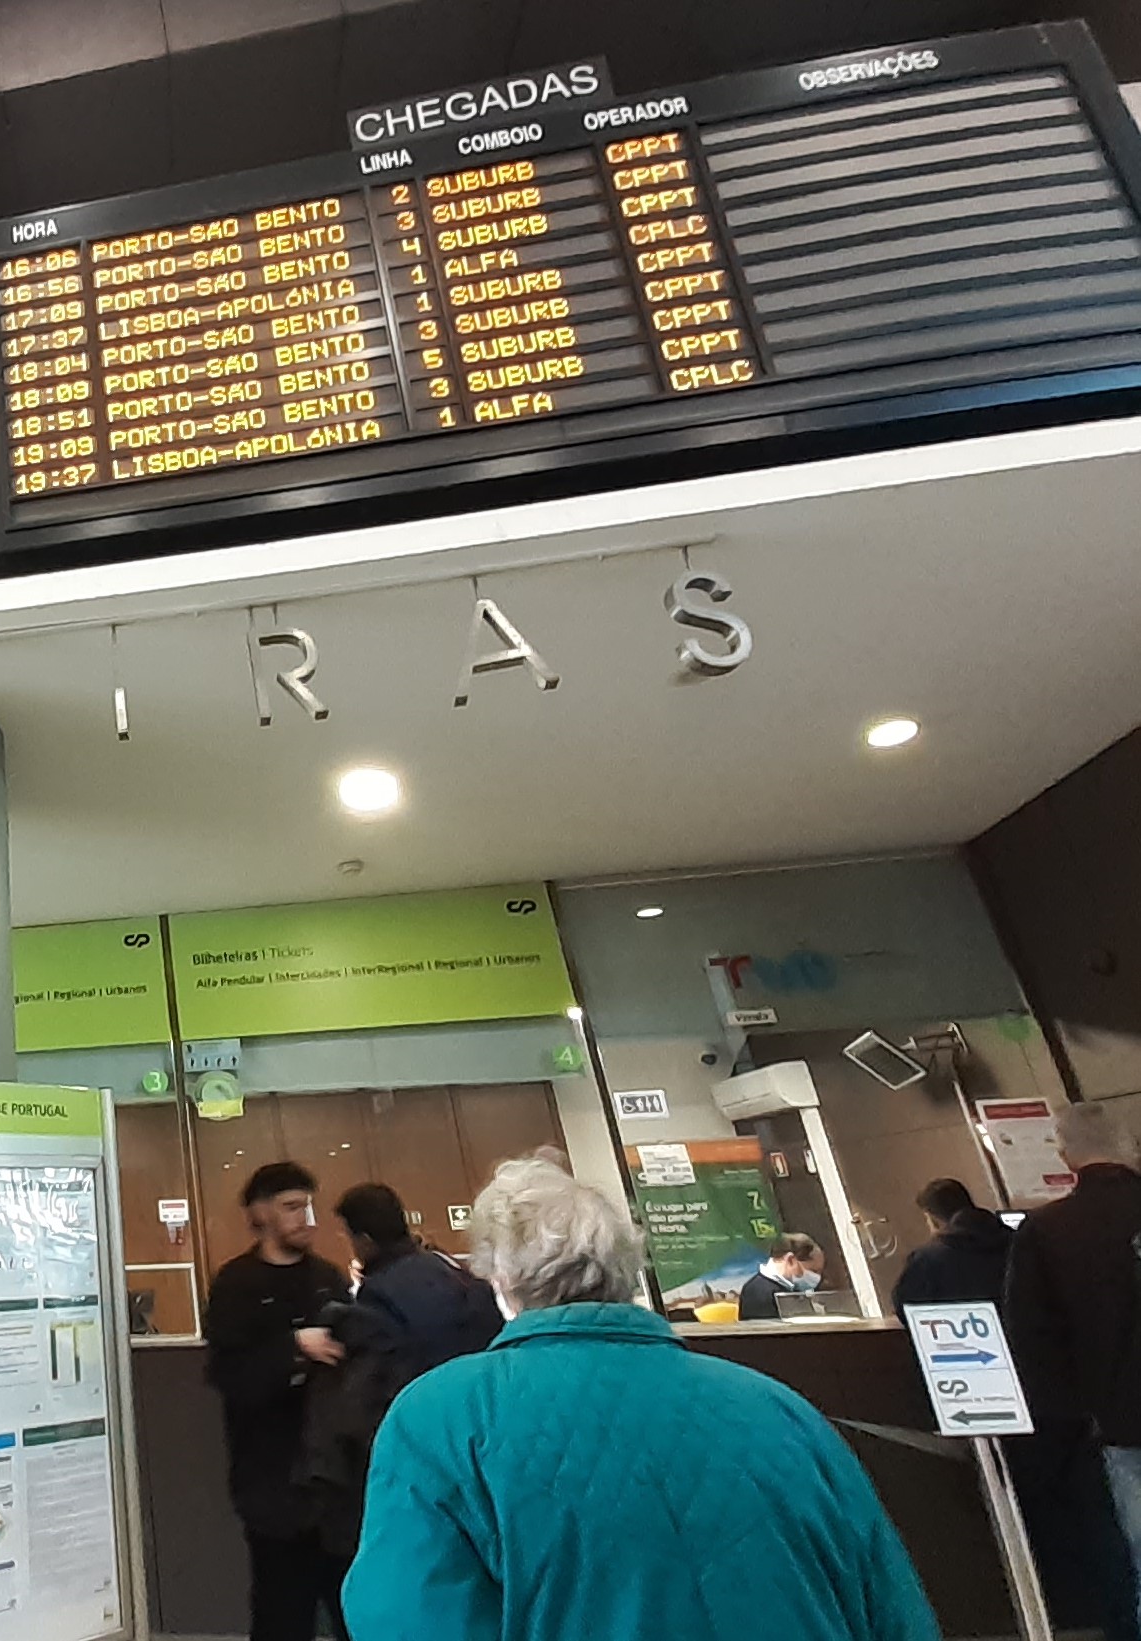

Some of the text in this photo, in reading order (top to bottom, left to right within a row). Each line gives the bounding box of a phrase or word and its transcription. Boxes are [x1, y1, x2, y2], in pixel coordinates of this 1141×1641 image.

[12, 49, 940, 244] HORA LINHA COMBOIO OPERADOR OBSERVAÇÕES
[354, 64, 600, 143] CHEGADAS
[3, 275, 80, 306] 16:56
[259, 224, 345, 258] BENTO
[396, 212, 416, 231] 3
[432, 187, 542, 225] SUBURB
[613, 160, 688, 190] CPPT
[255, 198, 341, 232] BENTO
[391, 184, 410, 206] 2
[426, 161, 535, 199] SUBURB
[606, 133, 680, 164] CPPT
[5, 300, 82, 331] 17:09
[263, 250, 350, 285] BENTO
[402, 238, 421, 256] 4
[437, 213, 548, 251] SUBURB
[621, 187, 696, 218] CPPT
[7, 215, 708, 358] 17:37 LISBOA-APOLÓNIA 1 ALFA CPLC
[9, 352, 87, 385] 18:04
[271, 304, 360, 339] BENTO
[416, 292, 432, 313] 1
[450, 269, 562, 306] SUBURB
[636, 241, 714, 274] CPPT
[10, 380, 89, 412] 18:09
[275, 333, 365, 367] BENTO
[420, 320, 438, 340] 3
[455, 297, 569, 335] SUBURB
[644, 269, 726, 303] CPPT
[11, 408, 92, 439] 18:51
[278, 361, 370, 395] BENTO
[422, 349, 444, 370] 5
[460, 326, 577, 364] SUBURB
[652, 299, 731, 332] CPPT
[13, 435, 94, 467] 19:09
[283, 390, 375, 424] BENTO
[429, 378, 450, 398] 3
[467, 356, 584, 393] SUBURB
[660, 328, 740, 362] CPPT
[15, 358, 754, 495] 19:37 LISBOA-APOLÓNIA 1 ALFA CPLC
[193, 950, 258, 966] Bilheteiras
[196, 977, 217, 989] Alfa
[221, 974, 265, 987] Pendular
[11, 1103, 68, 1118] PORTUGAL
[149, 1071, 162, 1092] 3
